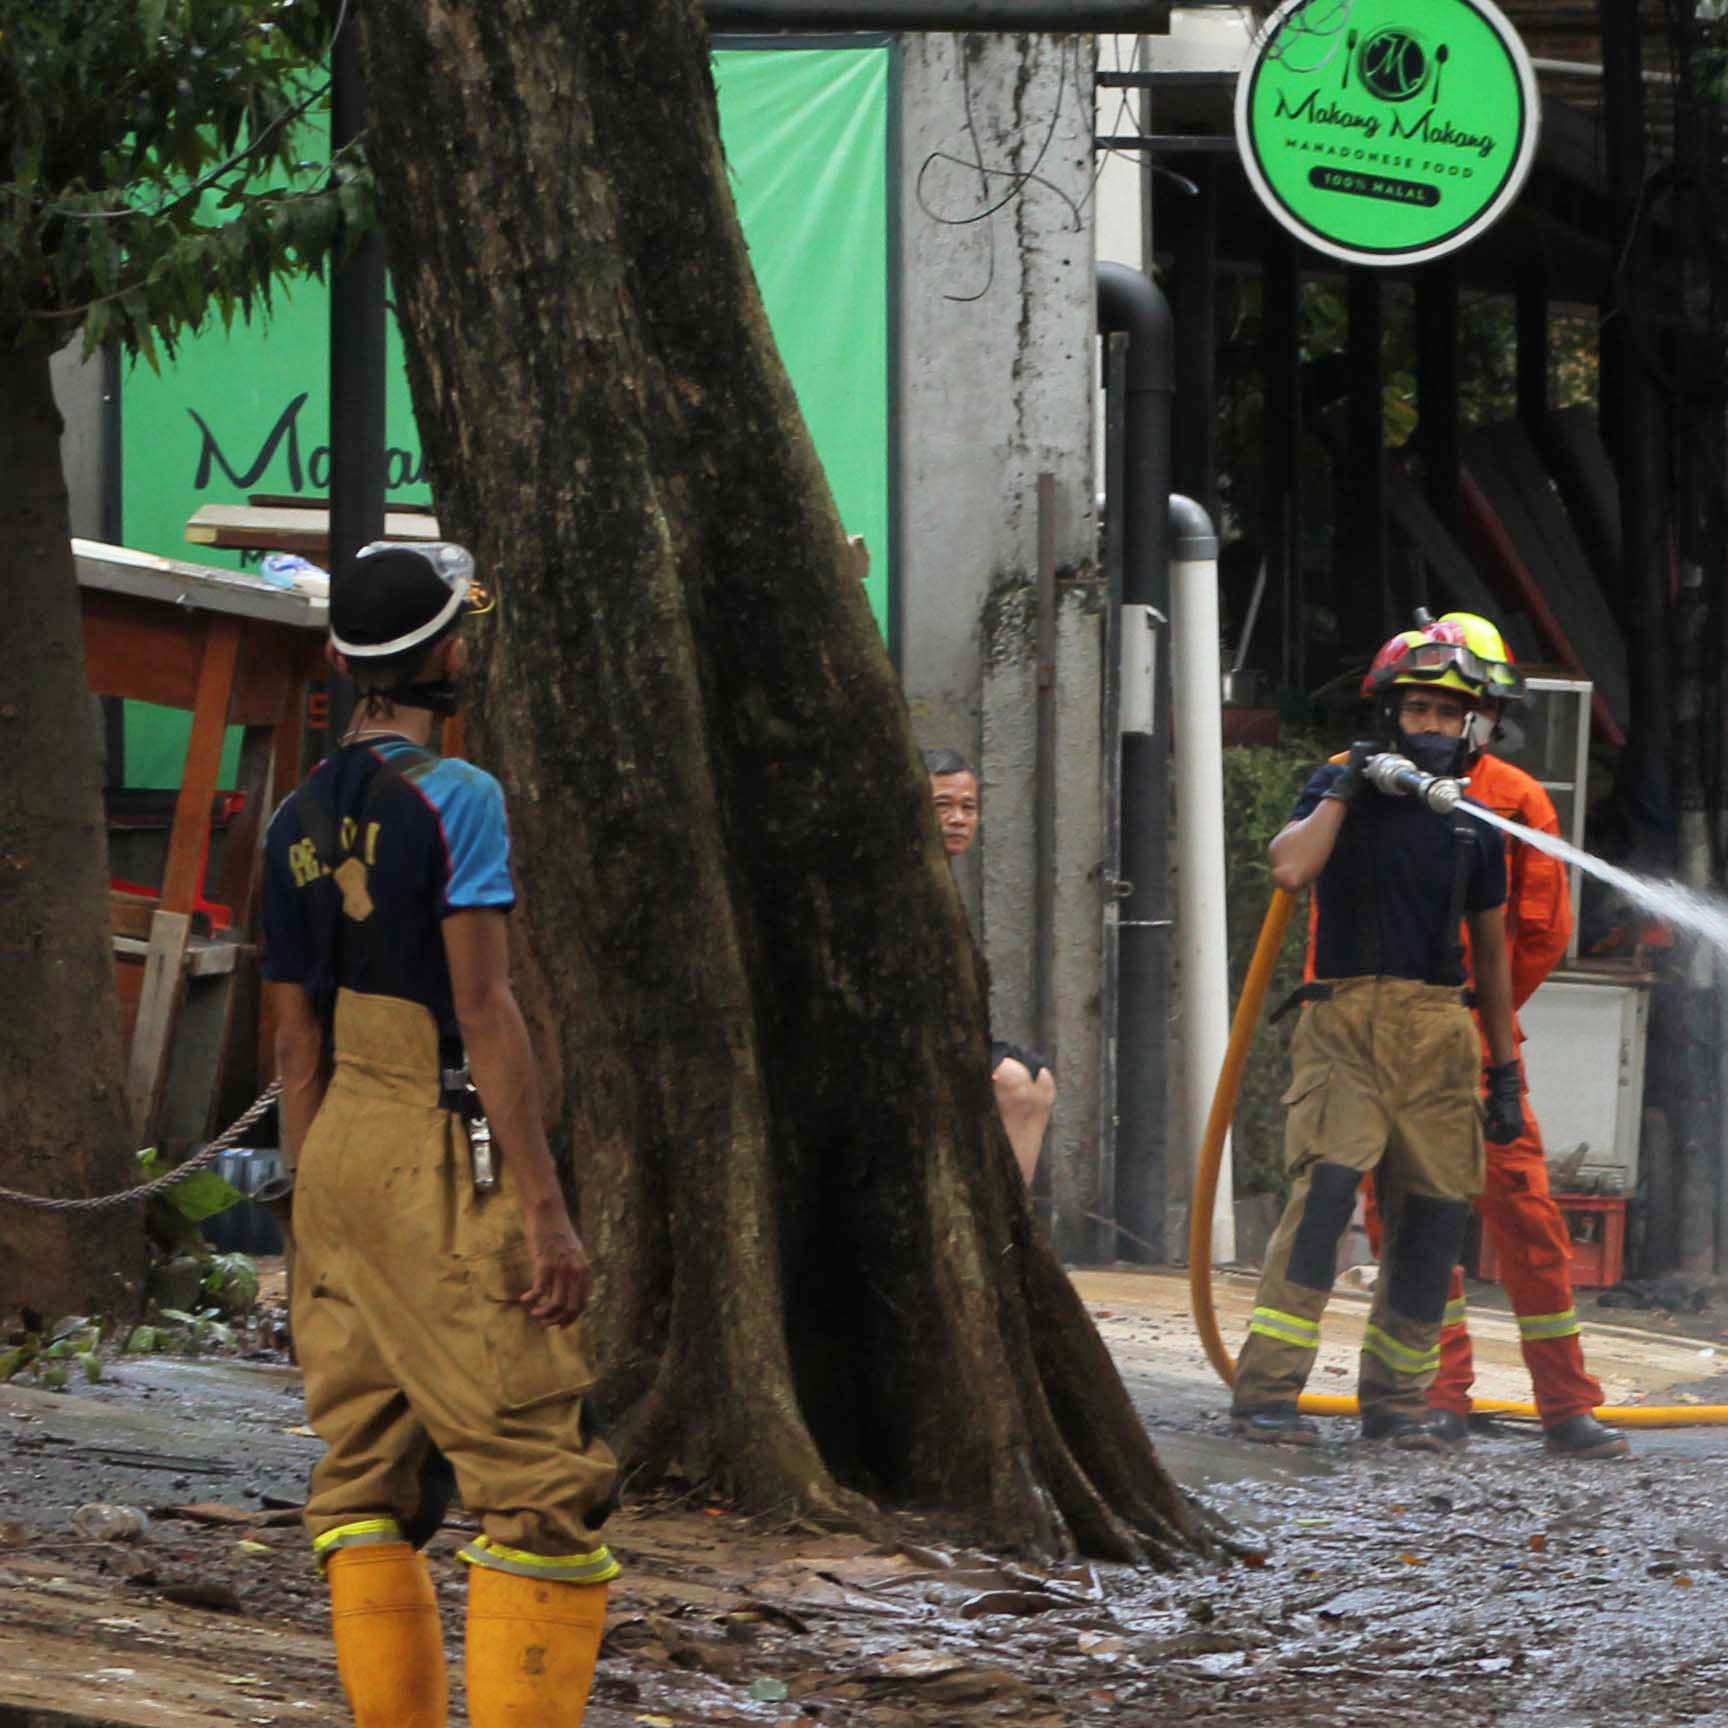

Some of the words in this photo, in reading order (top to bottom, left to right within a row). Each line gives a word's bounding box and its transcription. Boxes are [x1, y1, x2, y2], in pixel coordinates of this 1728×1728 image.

[1274, 88, 1381, 138] Makang
[1389, 108, 1496, 158] Makang
[1285, 138, 1413, 169] MANADONESE
[1421, 160, 1474, 178] FOOD
[1323, 172, 1368, 191] 100%
[1371, 181, 1426, 201] HALAL
